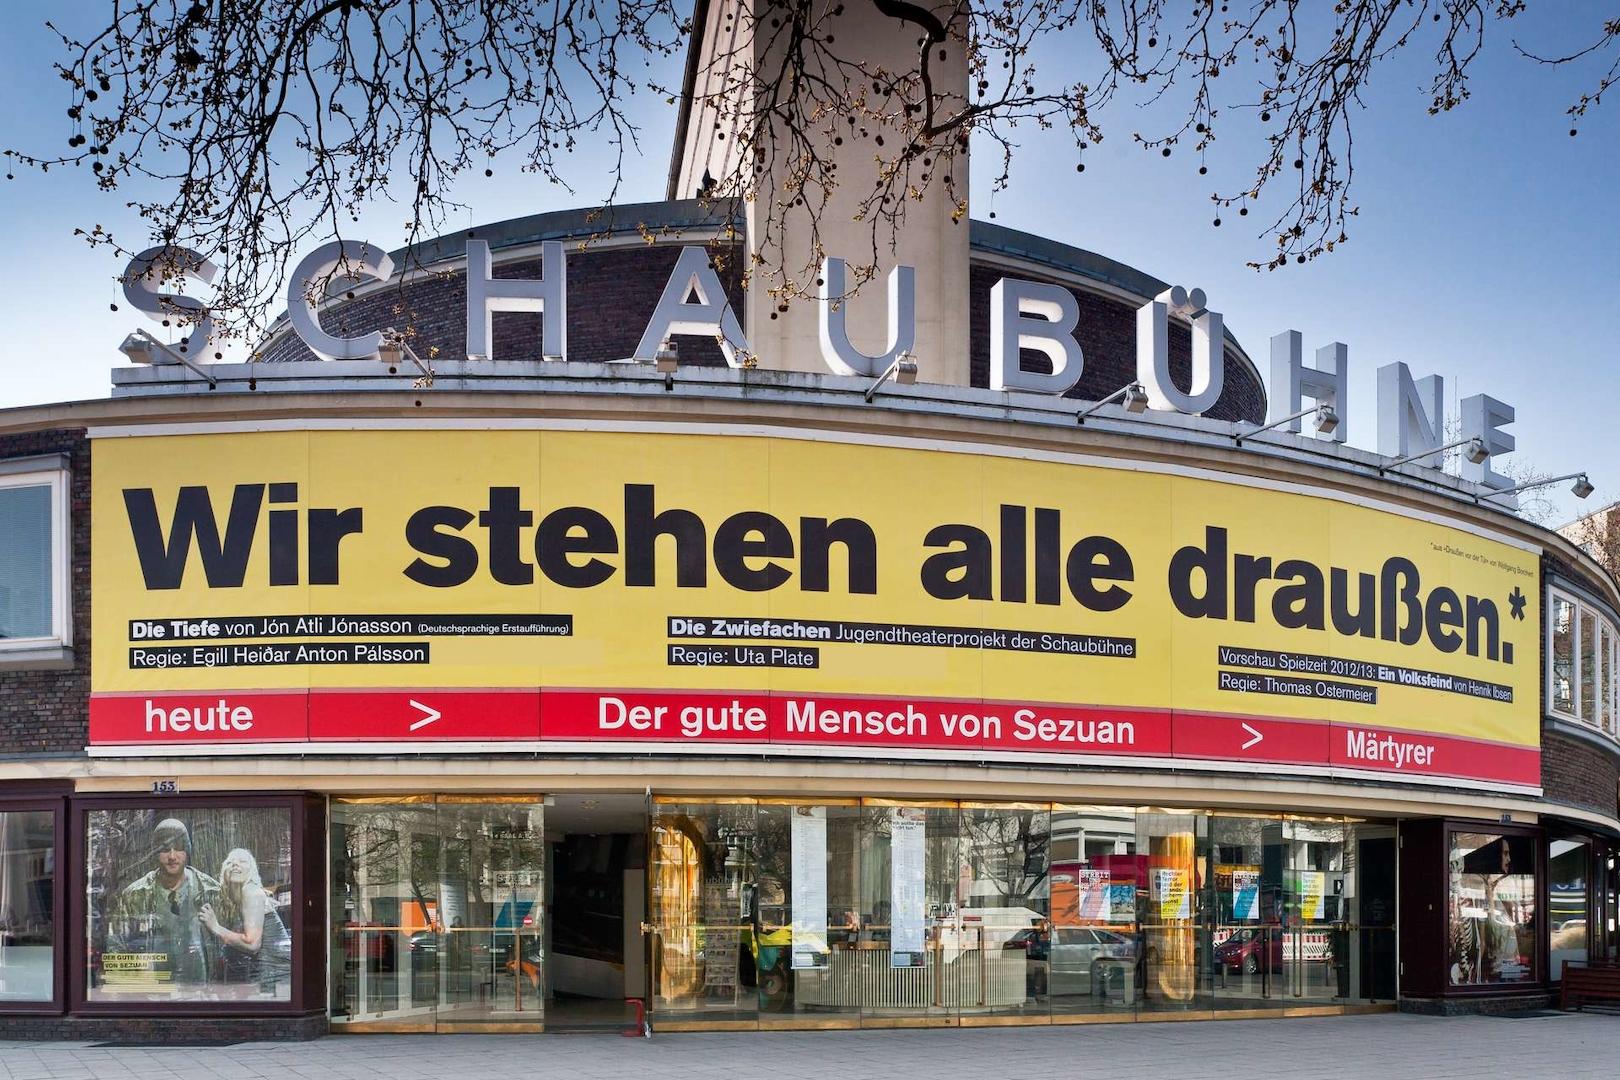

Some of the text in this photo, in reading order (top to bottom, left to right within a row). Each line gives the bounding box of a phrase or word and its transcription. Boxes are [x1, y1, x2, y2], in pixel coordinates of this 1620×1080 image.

[122, 239, 1515, 486] SCHAUBÜHNE
[122, 482, 362, 590] Wir
[403, 484, 876, 594] stehen
[920, 504, 1134, 612] alle
[132, 617, 569, 638] Die Tiefe von Jón Atli Jónasson (Deutschsprachige Erstaufführung)
[671, 619, 1133, 656] Die Zwiefachen Jugendtheaterprojekt der Schaubühne
[133, 644, 424, 668] Regie: Egill Heiðar Anton Pálsson
[672, 647, 814, 666] Regie: Uta Plate
[1221, 648, 1276, 667] Vorschau
[1279, 654, 1327, 672] Spielzeit
[1331, 660, 1376, 678] 2012/13:
[1378, 666, 1396, 682] Ein
[1399, 669, 1453, 689] Volksfeind
[1454, 682, 1467, 692] von
[1469, 681, 1492, 697] Henrik
[1221, 673, 1373, 702] Regie: Thomas Ostermeier
[145, 697, 1434, 768] heute Der gute Mensch von Sezuan Märtyrer
[153, 781, 175, 792] 153
